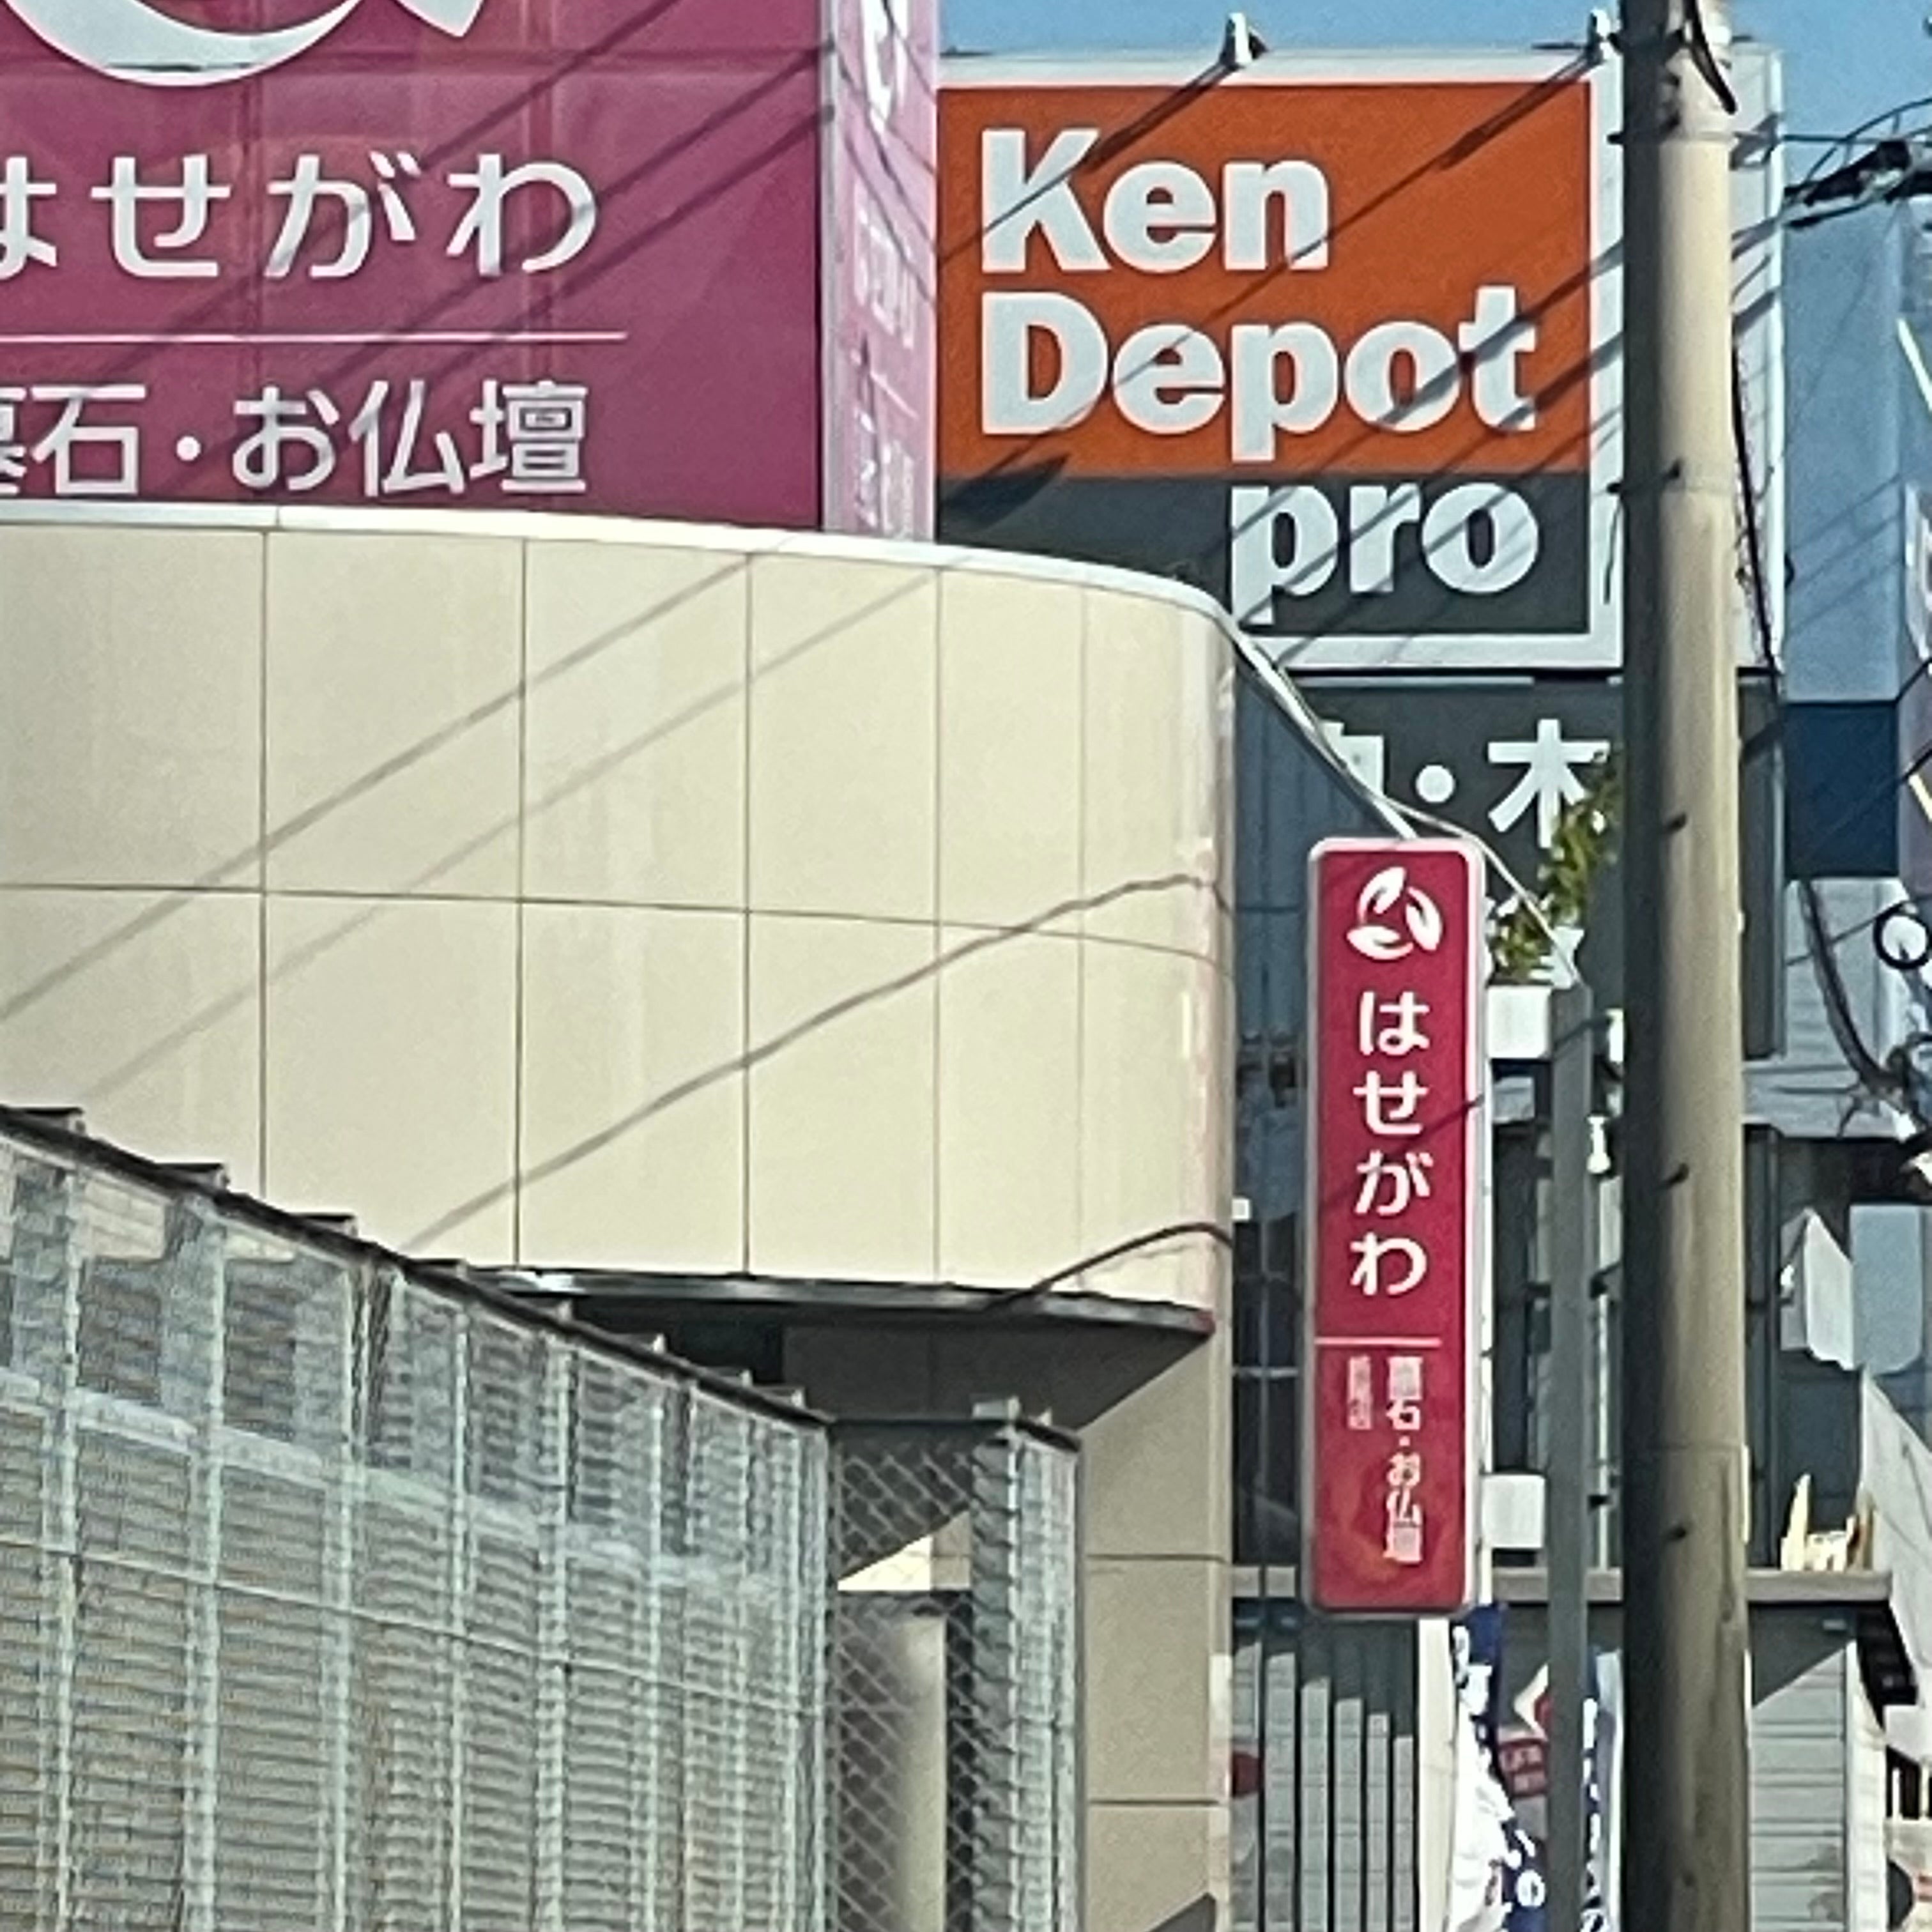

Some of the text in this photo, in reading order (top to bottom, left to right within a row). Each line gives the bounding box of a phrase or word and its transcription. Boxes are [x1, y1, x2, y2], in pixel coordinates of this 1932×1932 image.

[981, 128, 1329, 273] Ken
[0, 380, 586, 496] 石・お仏壇
[981, 285, 1536, 462] Depot
[1231, 482, 1538, 625] pro
[1350, 991, 1434, 1296] はせがわ
